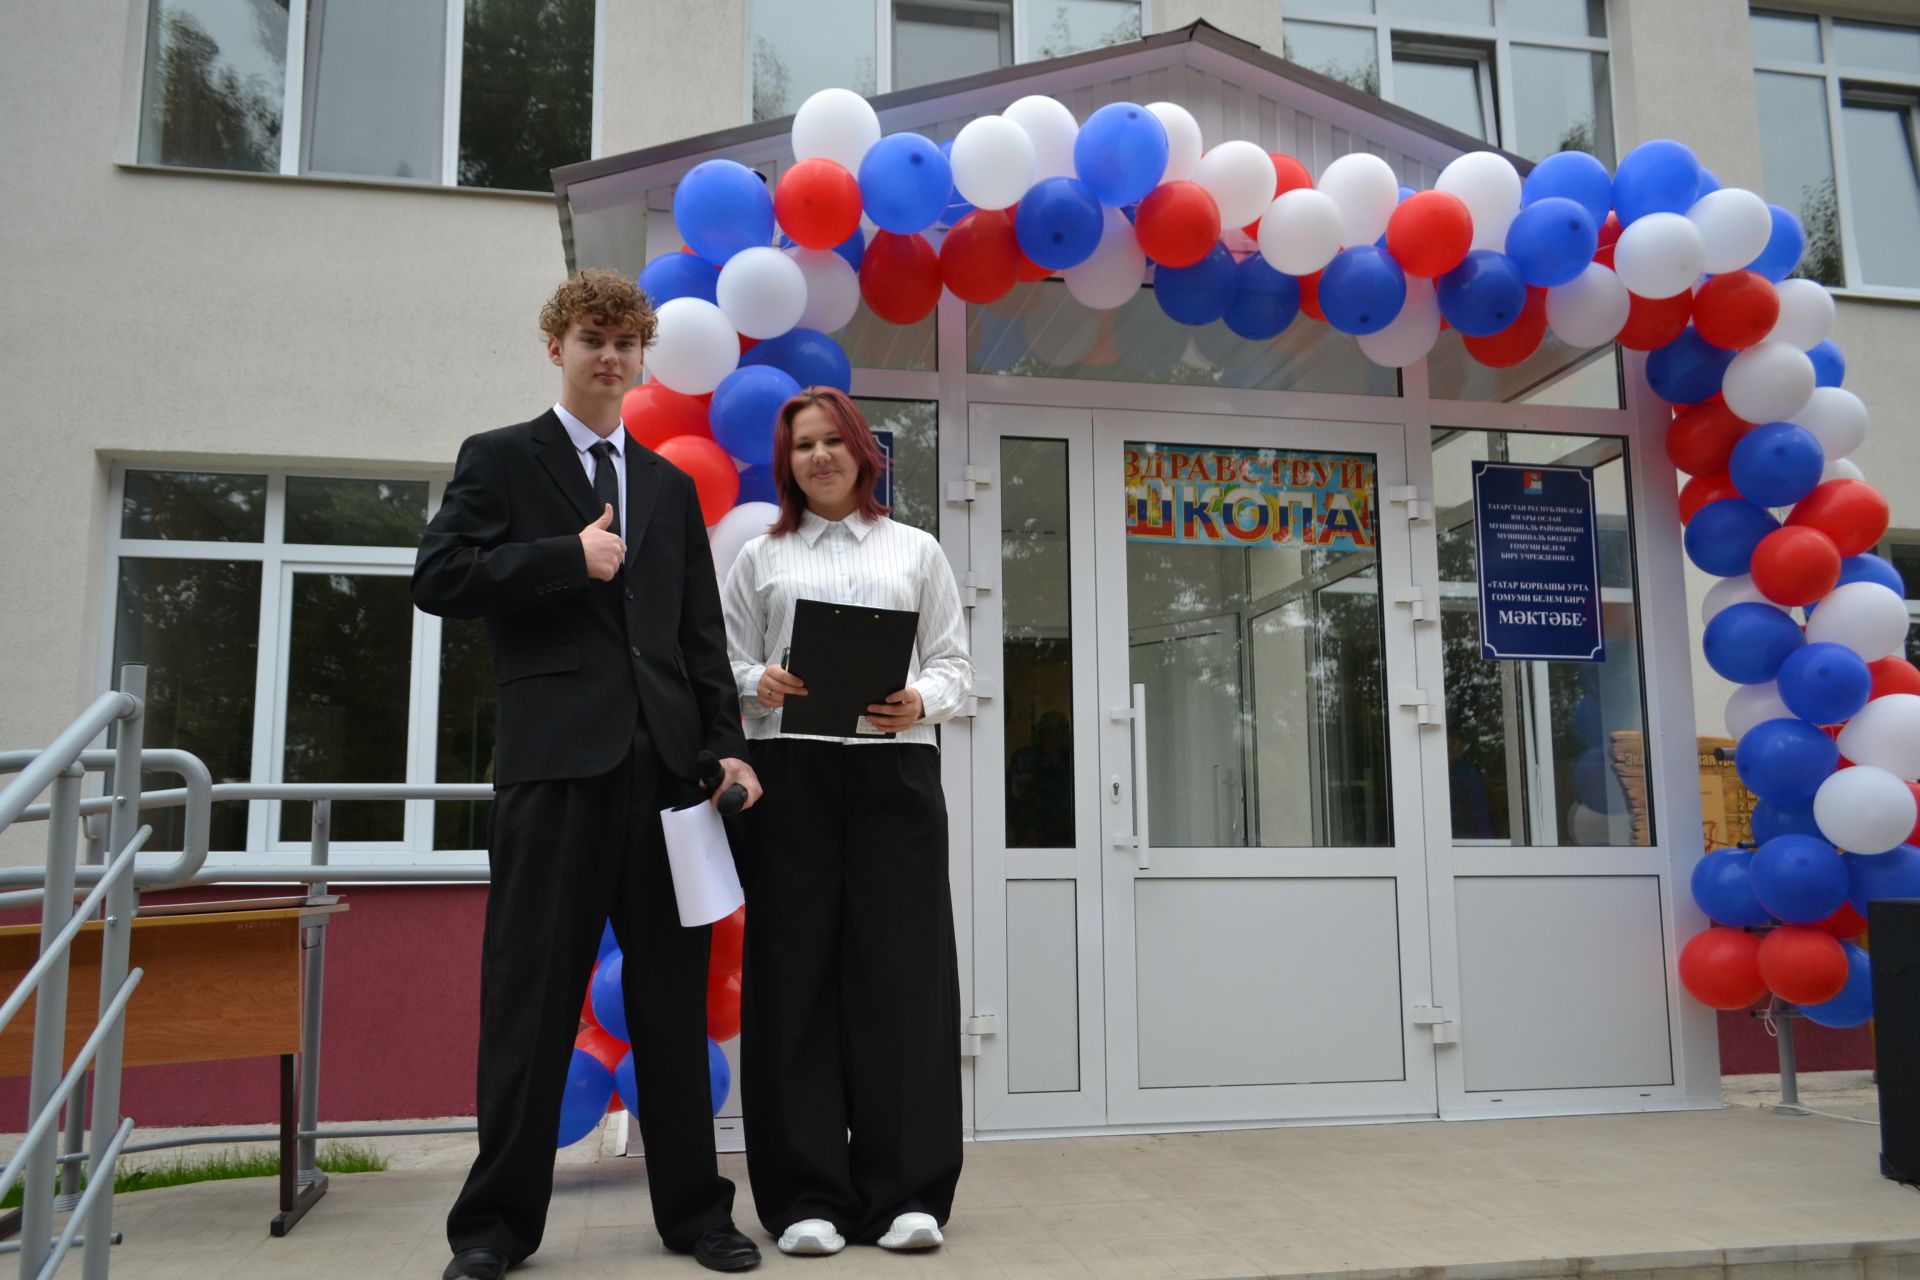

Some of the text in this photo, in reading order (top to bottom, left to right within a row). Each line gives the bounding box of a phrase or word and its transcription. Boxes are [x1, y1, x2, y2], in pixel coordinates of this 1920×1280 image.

[1488, 503, 1583, 514] ТАТАРСТАН РЕСПУБЛИКАСЫ
[1489, 523, 1538, 531] МУНИЦИПАЛЬ
[1497, 533, 1577, 543] МУНИЦИПАЛЬ БЮДЖЕТ
[1510, 543, 1566, 552] ГОМУМИ БЕЛЕМ
[1520, 553, 1575, 562] УЧРЕЖДЕНИЕСЕ
[1488, 581, 1589, 592] «ТАТАР БОРНАШЫ УРТА
[1492, 593, 1531, 602] ГОМУМИ
[1532, 594, 1563, 603] БЕЛЕМ
